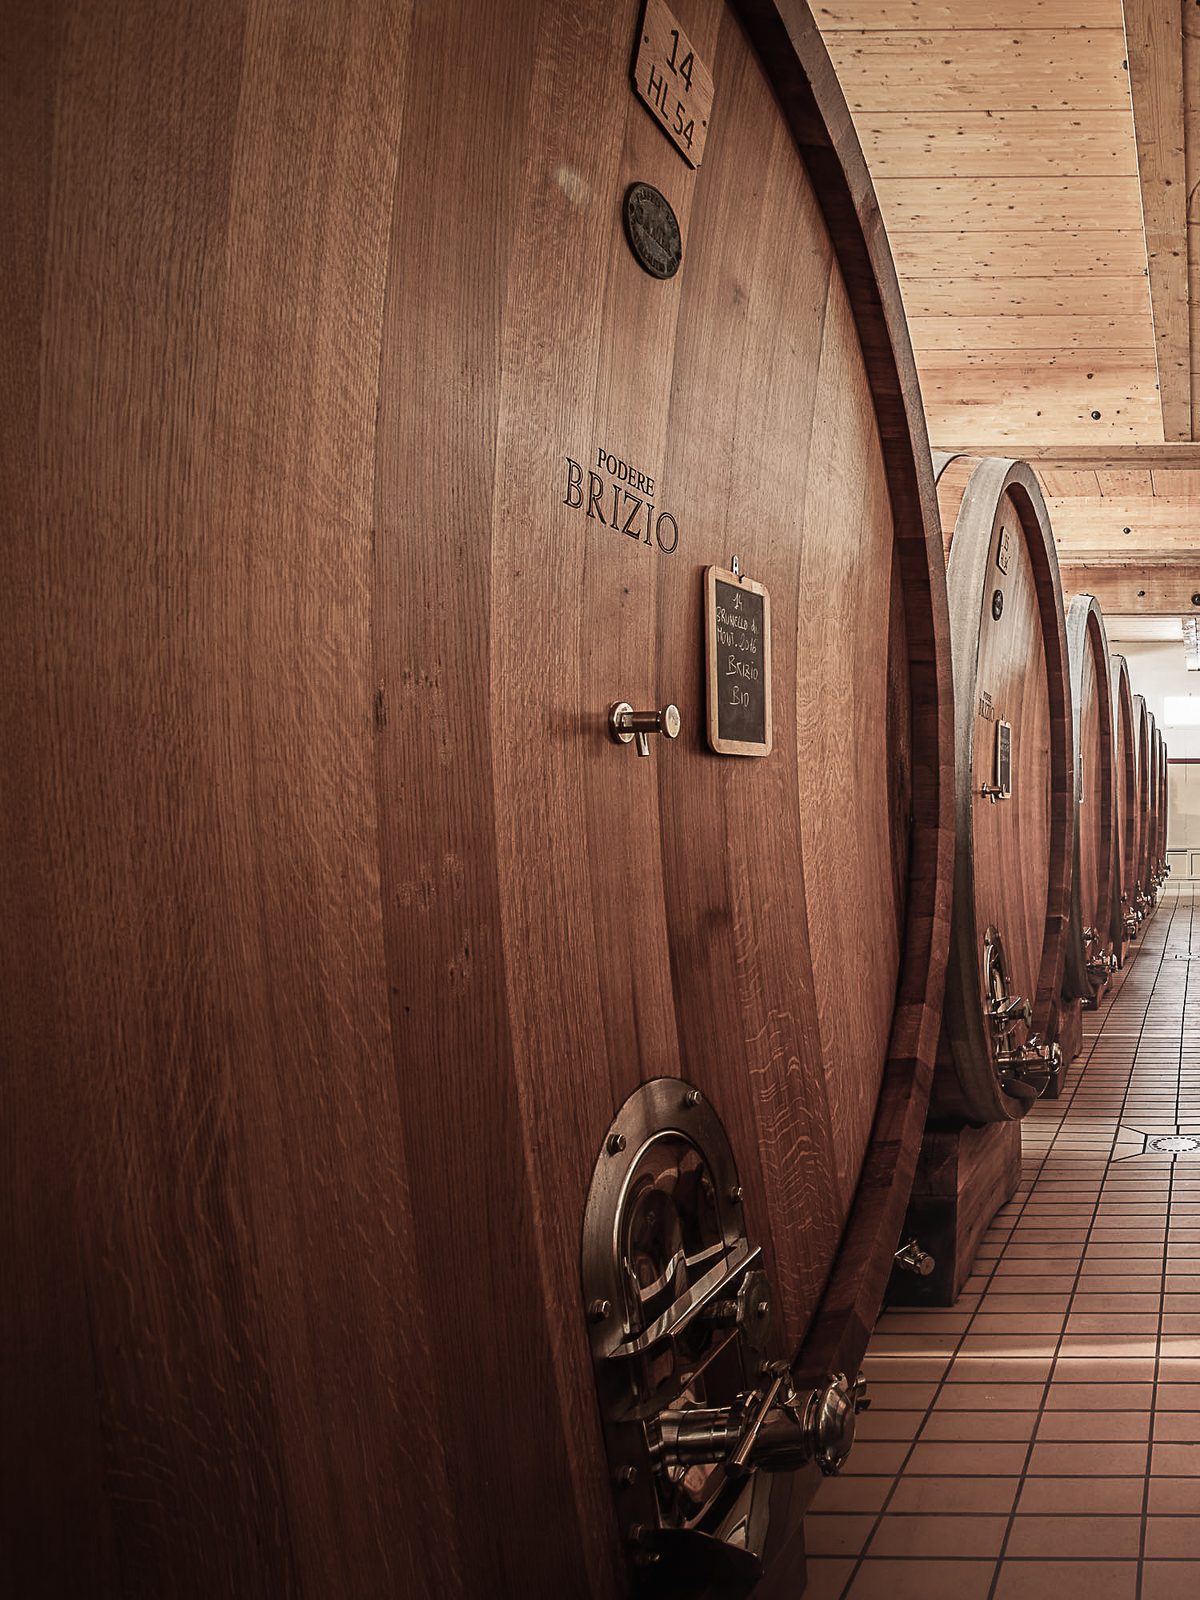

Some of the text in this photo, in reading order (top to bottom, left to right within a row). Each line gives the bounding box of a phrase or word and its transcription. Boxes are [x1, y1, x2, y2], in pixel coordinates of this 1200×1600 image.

[666, 29, 695, 93] 14
[647, 64, 695, 150] HL 54
[562, 456, 679, 554] BRIZIO
[597, 447, 655, 498] PODERE
